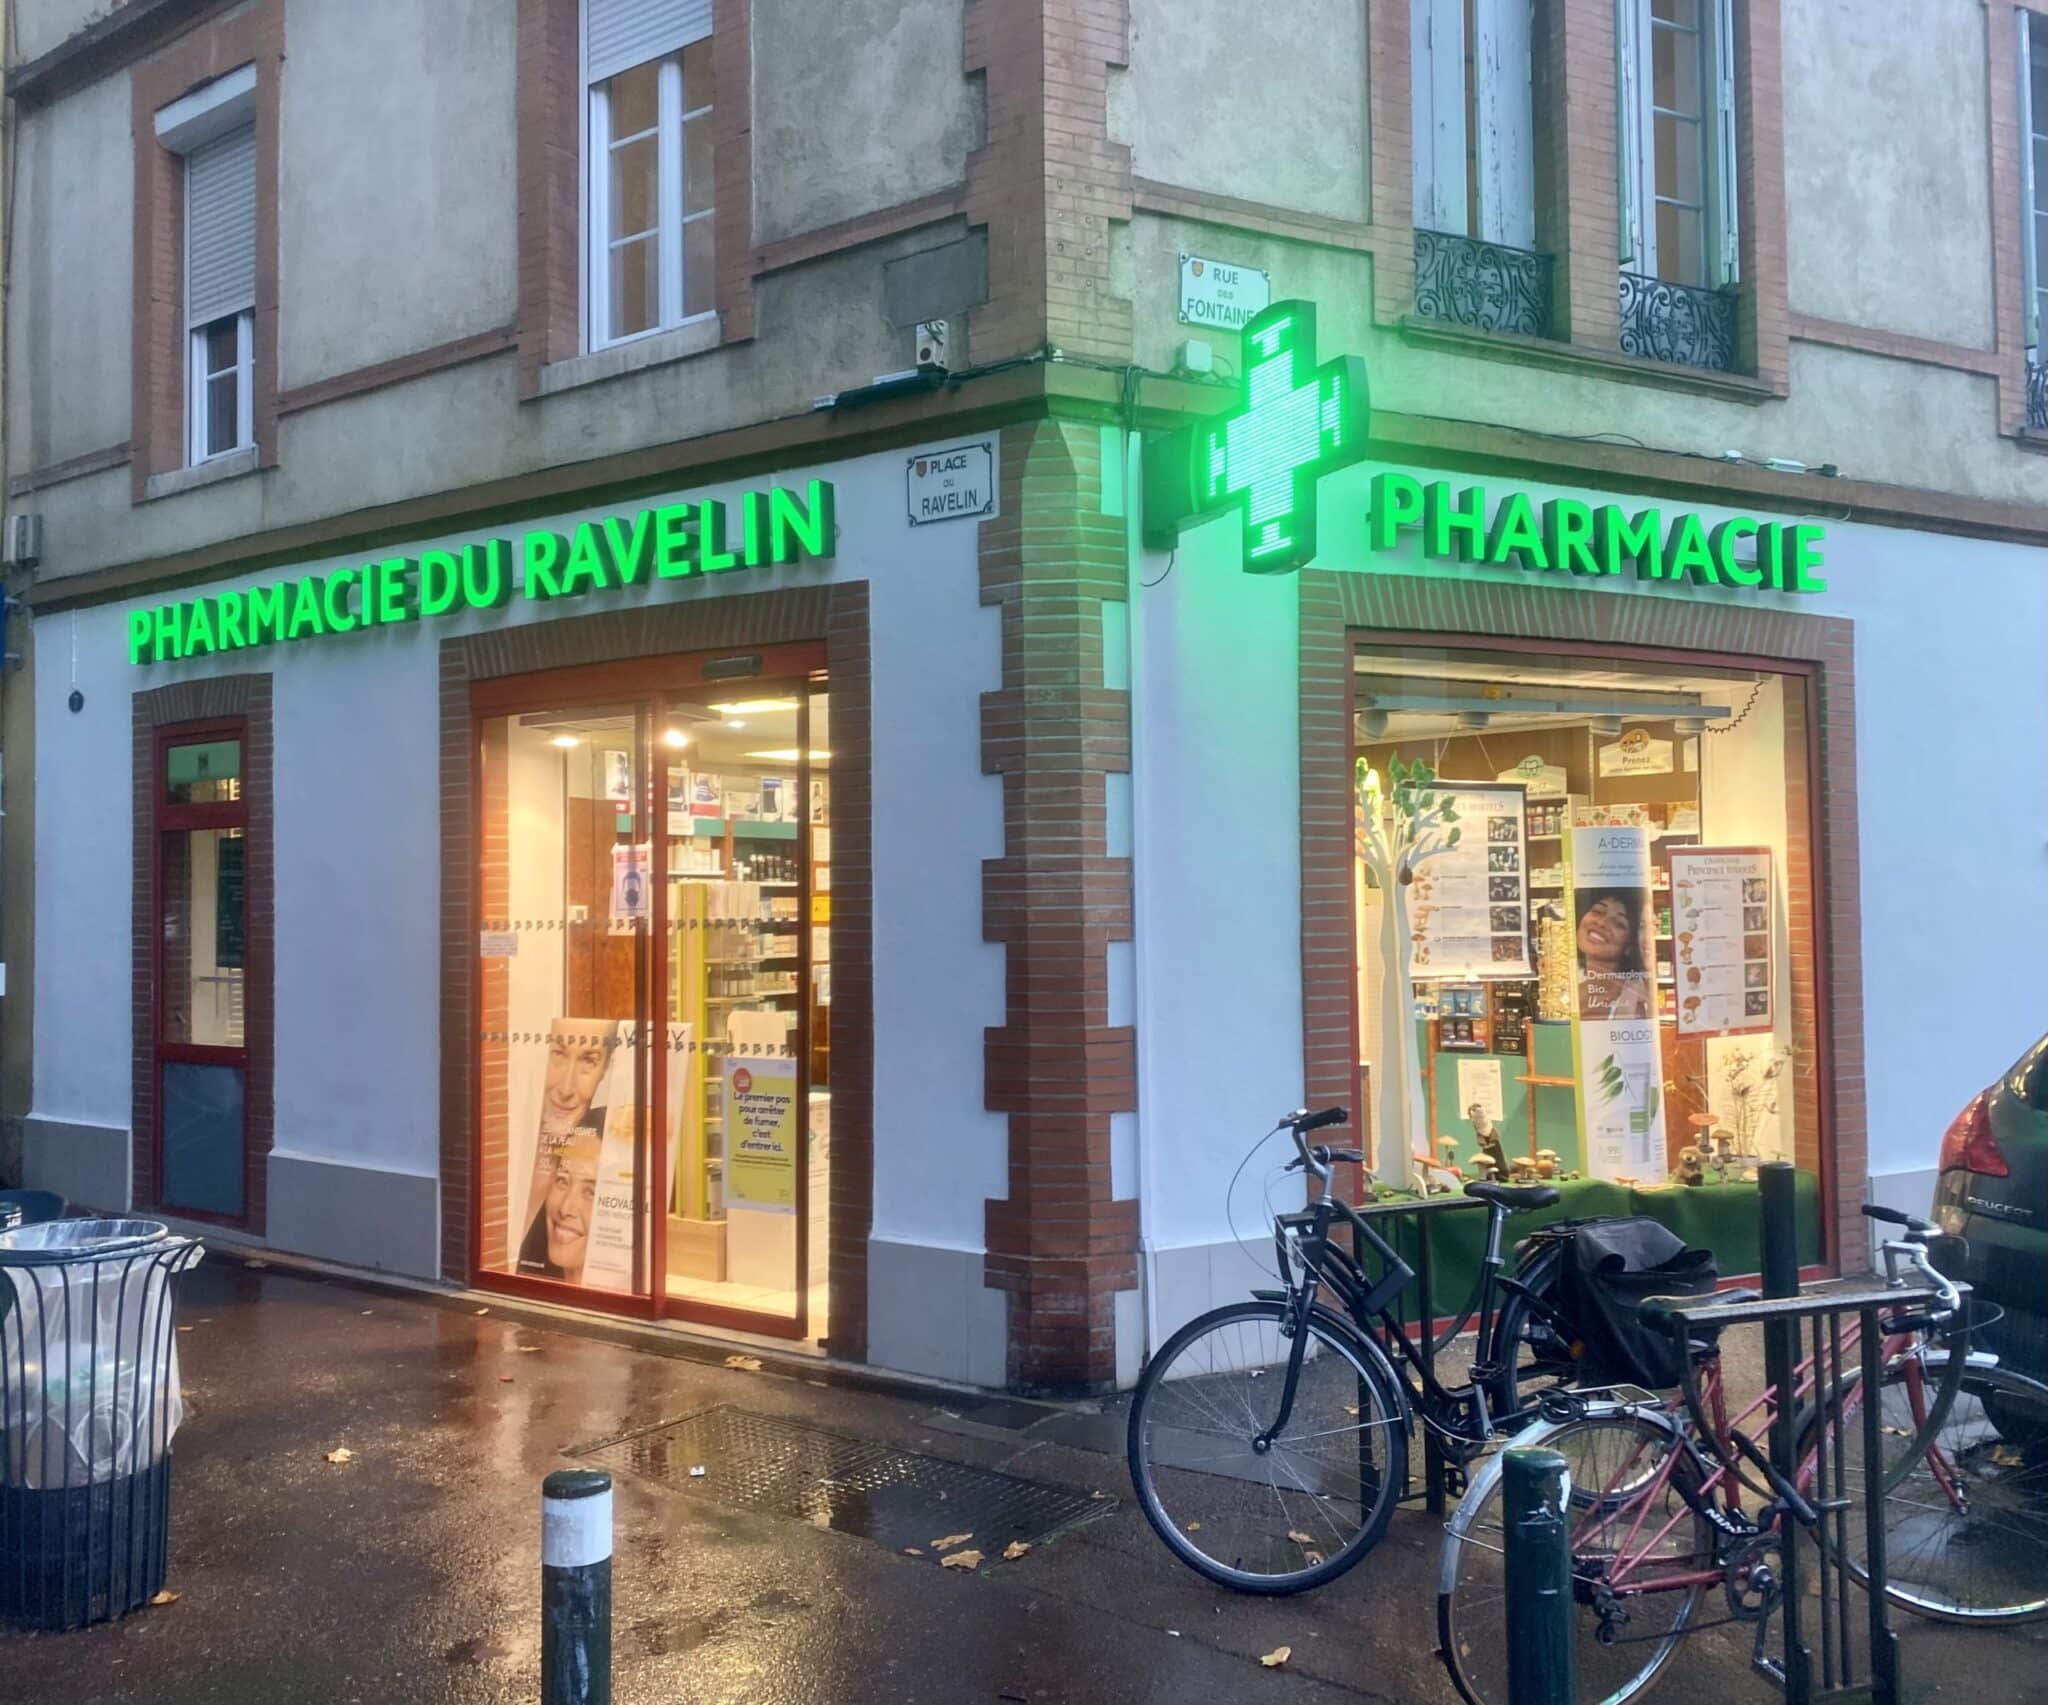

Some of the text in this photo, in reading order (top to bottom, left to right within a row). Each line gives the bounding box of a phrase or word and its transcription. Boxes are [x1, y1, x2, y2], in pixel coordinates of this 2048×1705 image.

[1213, 267, 1239, 285] RUE
[930, 455, 967, 474] PLACE
[943, 479, 954, 488] DU
[922, 488, 978, 516] RAVELIN
[1376, 472, 1827, 593] PHARMACIE
[128, 478, 827, 665] PHARMACIE DU RAVELIN
[744, 1092, 774, 1104] premier
[775, 1095, 791, 1105] pas
[738, 1104, 786, 1116] pour arrêter
[743, 1116, 753, 1125] de
